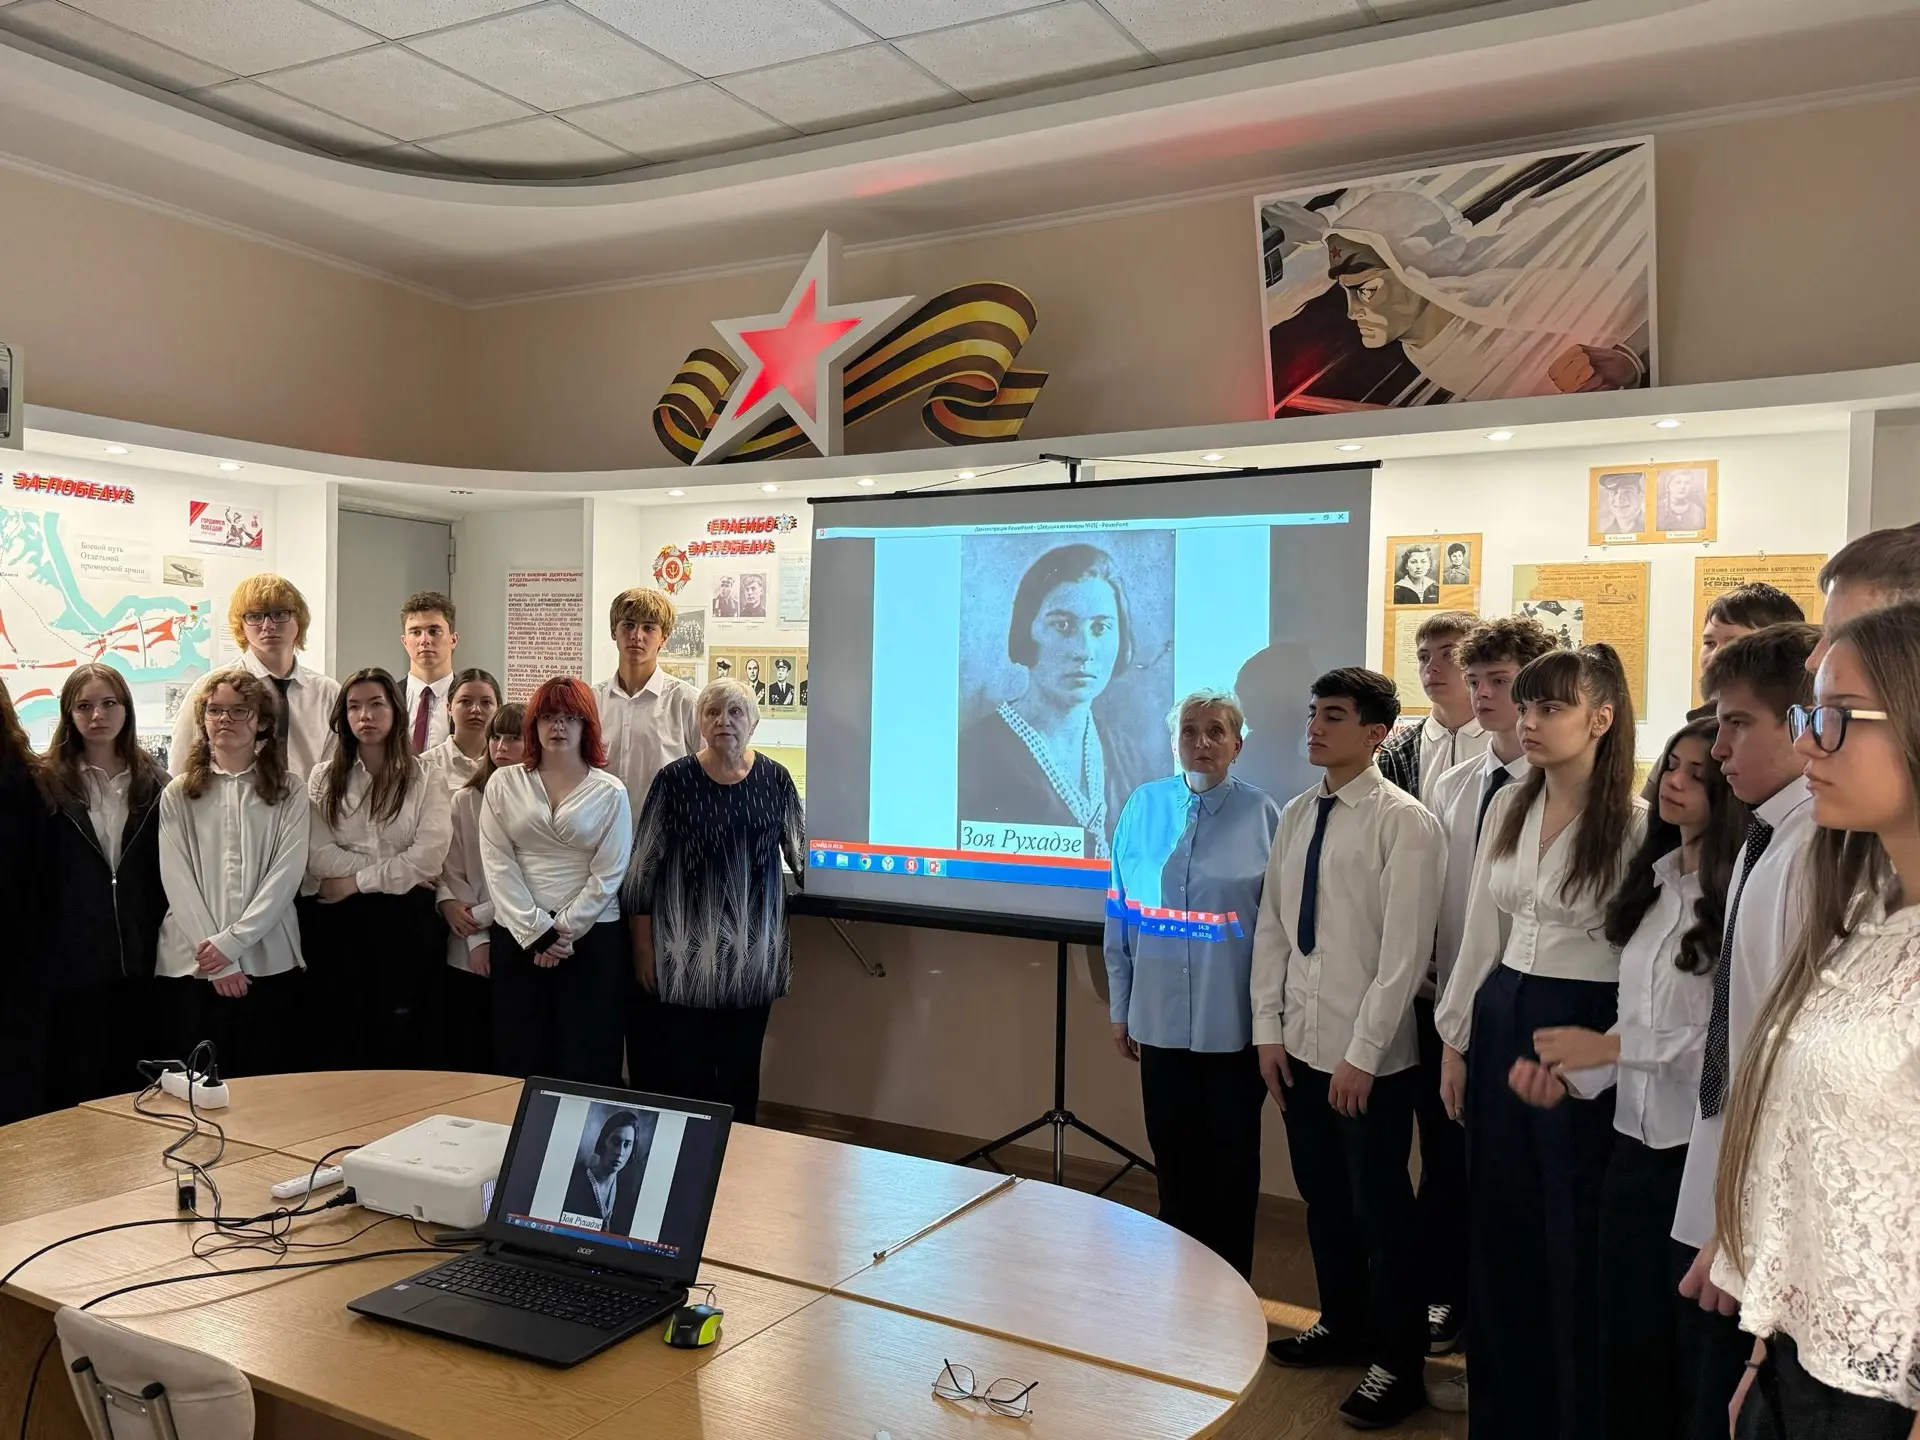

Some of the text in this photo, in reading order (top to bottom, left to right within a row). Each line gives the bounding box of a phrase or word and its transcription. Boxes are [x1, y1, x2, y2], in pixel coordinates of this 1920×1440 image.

[16, 471, 40, 492] ЗА
[709, 516, 775, 534] СПАСИБО
[81, 541, 124, 554] Боевой путь
[689, 541, 707, 556] ЗА
[80, 552, 119, 562] Отдельной
[80, 563, 123, 573] приморской
[961, 826, 1082, 855] Зоя Рухадзе
[561, 1212, 602, 1230] Зоя Рухадзе
[577, 1247, 595, 1255] acer
